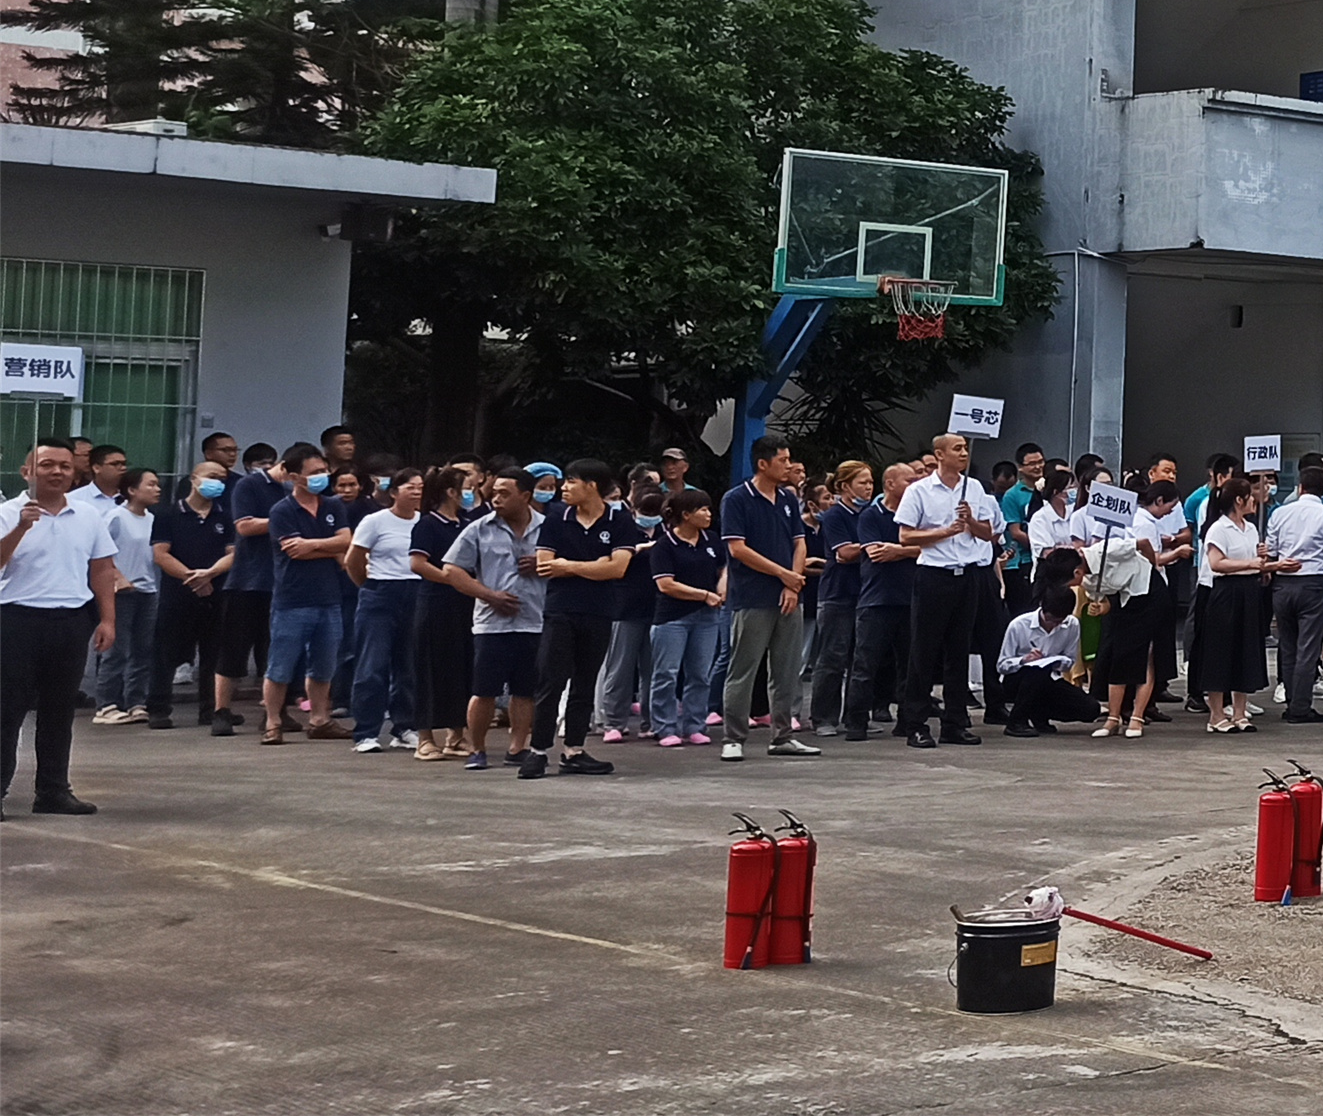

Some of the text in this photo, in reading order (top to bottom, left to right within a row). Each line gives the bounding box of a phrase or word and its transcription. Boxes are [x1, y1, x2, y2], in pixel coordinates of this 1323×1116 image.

[4, 356, 76, 380] 营销队
[953, 408, 1001, 426] 一号芯
[1246, 445, 1279, 461] 行政队
[1089, 492, 1132, 516] 企划队
